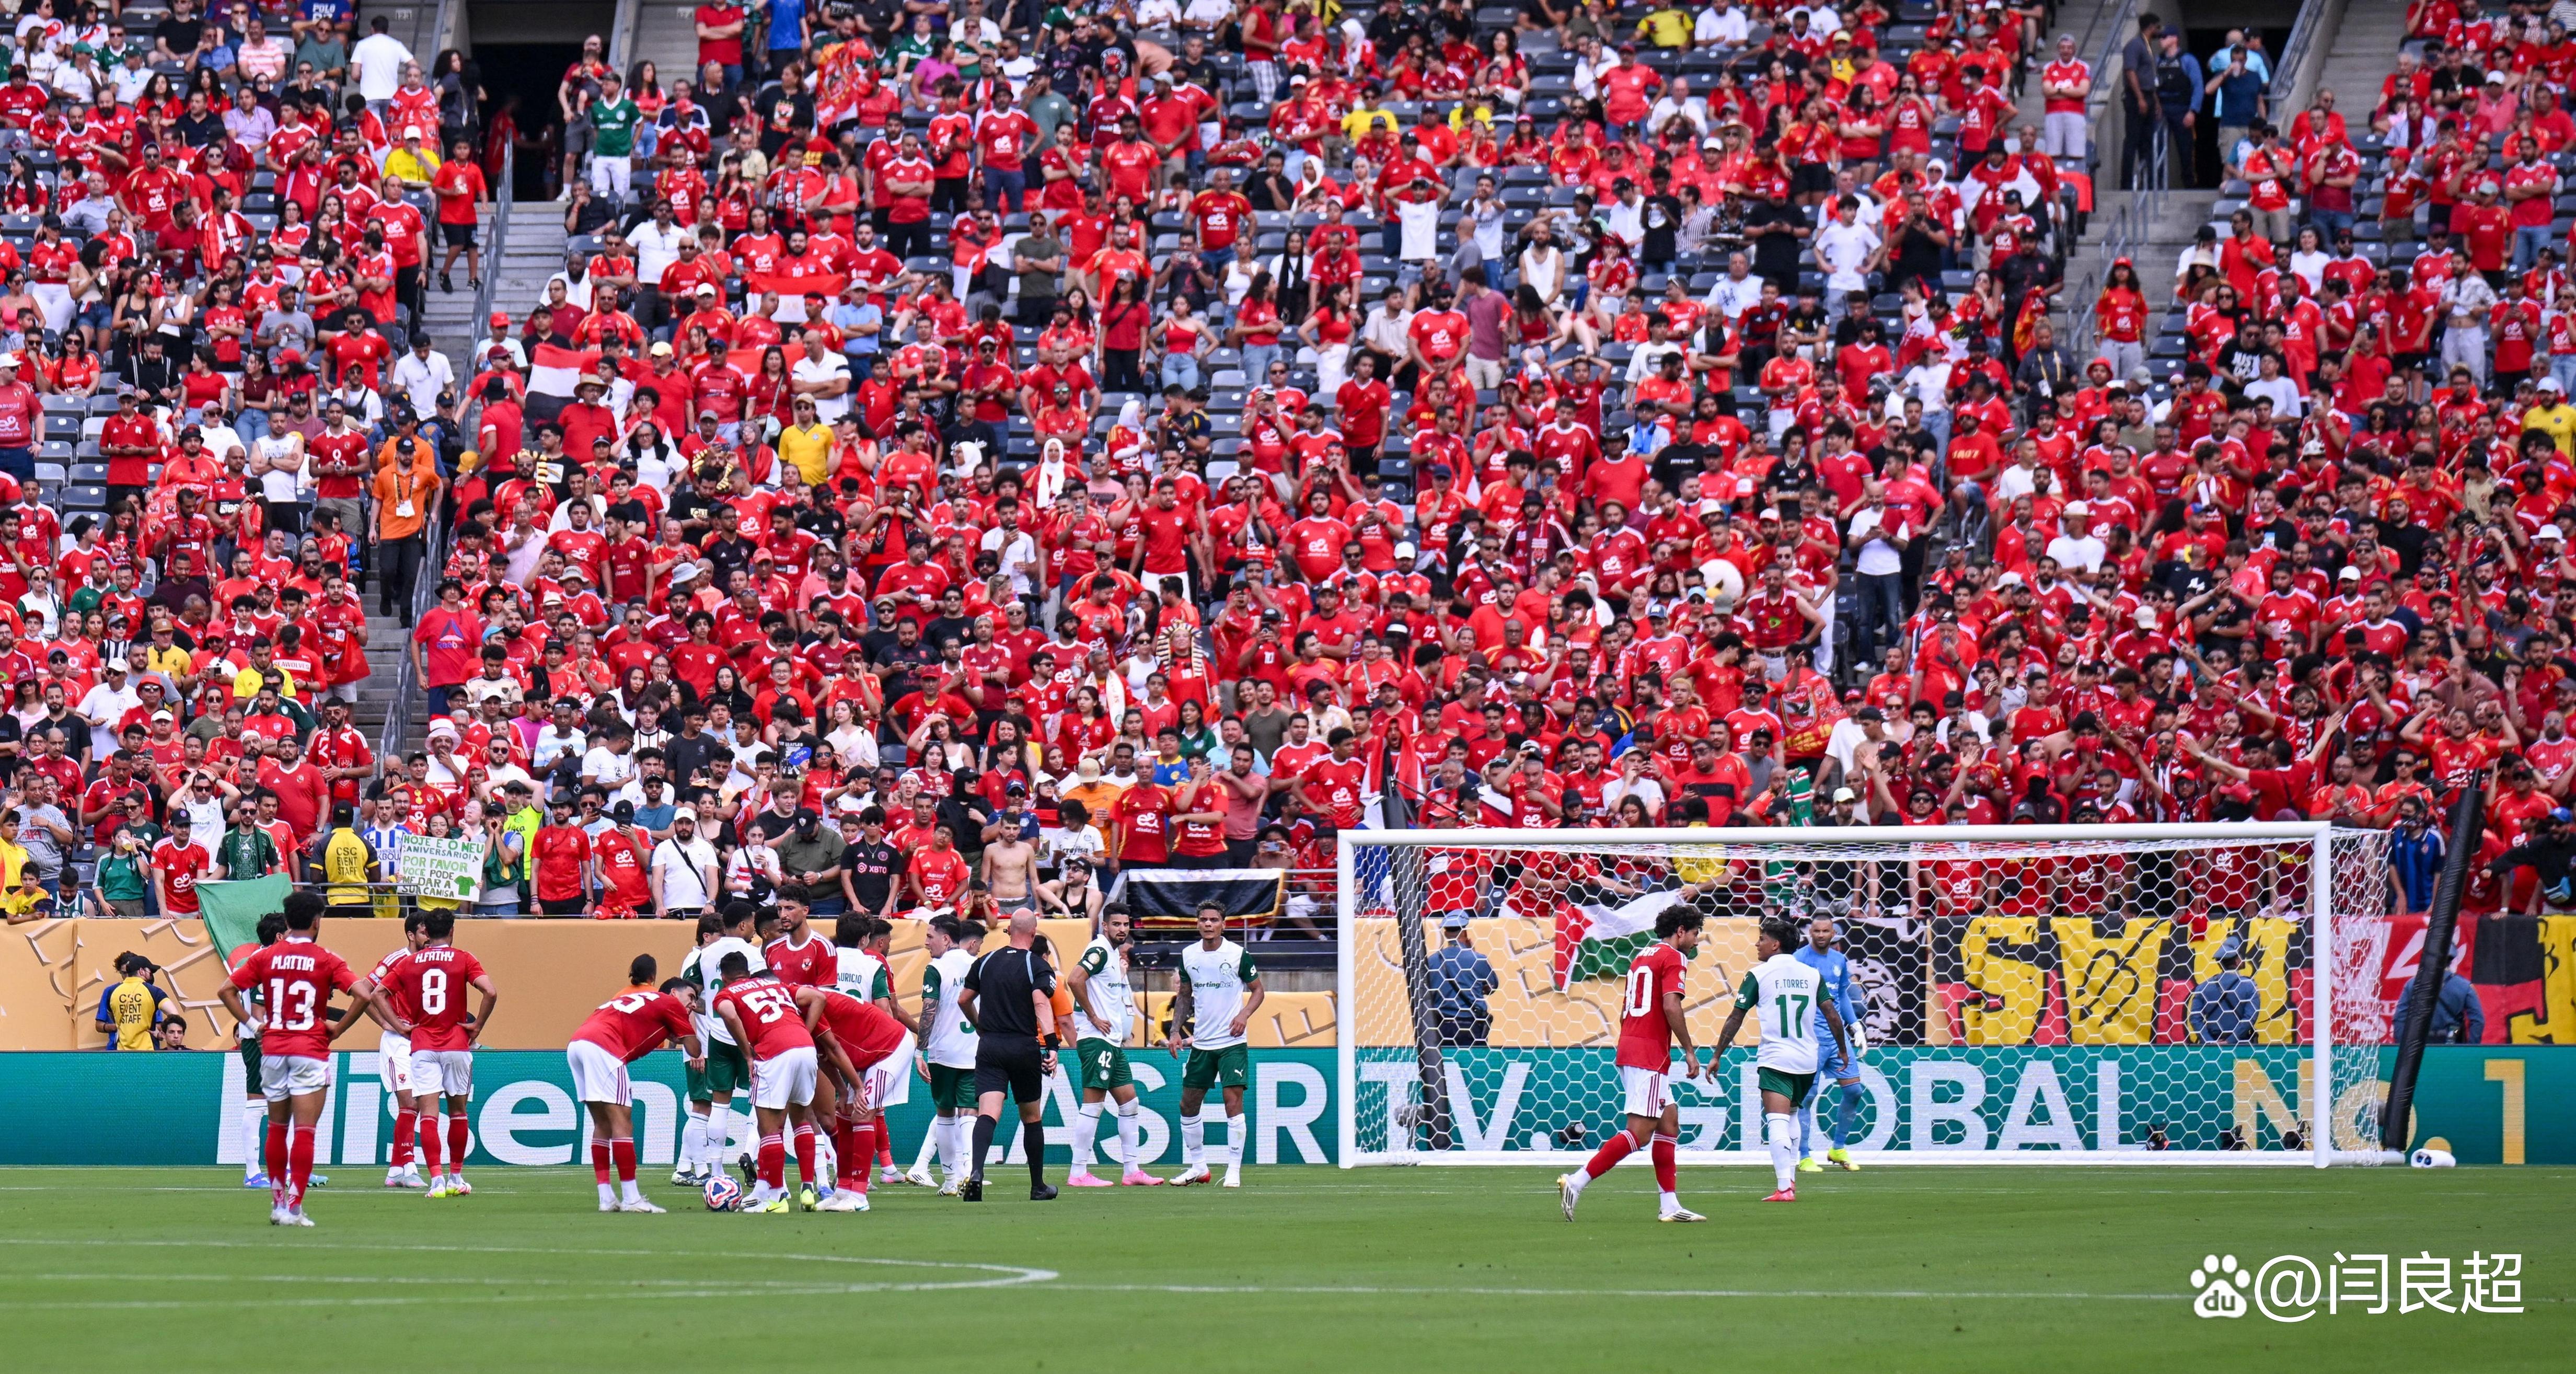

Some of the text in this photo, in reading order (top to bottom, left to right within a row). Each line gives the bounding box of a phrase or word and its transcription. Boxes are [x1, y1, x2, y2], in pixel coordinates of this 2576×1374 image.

[135, 426, 142, 434] R
[273, 662, 309, 670] SEAWOLVES
[1039, 701, 1047, 710] 10
[403, 835, 432, 847] HOJE
[448, 840, 458, 850] O
[461, 842, 484, 854] MEU
[336, 847, 357, 856] CSC
[337, 857, 357, 866] EVENT
[403, 856, 468, 873] POR FAVOR
[338, 867, 357, 876] STAFF
[869, 865, 887, 873] XBTO
[430, 869, 455, 881] PODE
[419, 877, 442, 888] DAR
[444, 880, 451, 889] A
[423, 887, 455, 898] CAMISA
[414, 951, 455, 964] H.FATHY
[271, 955, 315, 972] M.ATTIA
[836, 973, 862, 984] AURICIO
[422, 968, 447, 1015] 8
[119, 994, 142, 1003] CSC
[119, 1004, 142, 1014] EVENT
[270, 978, 317, 1031] 13
[741, 987, 801, 1024] 54
[119, 1014, 142, 1024] STAFF
[1775, 994, 1809, 1038] 17
[1098, 1050, 1112, 1068] 42
[216, 1052, 2526, 1165] Hisens ASER TV. GLOBAL No. 1
